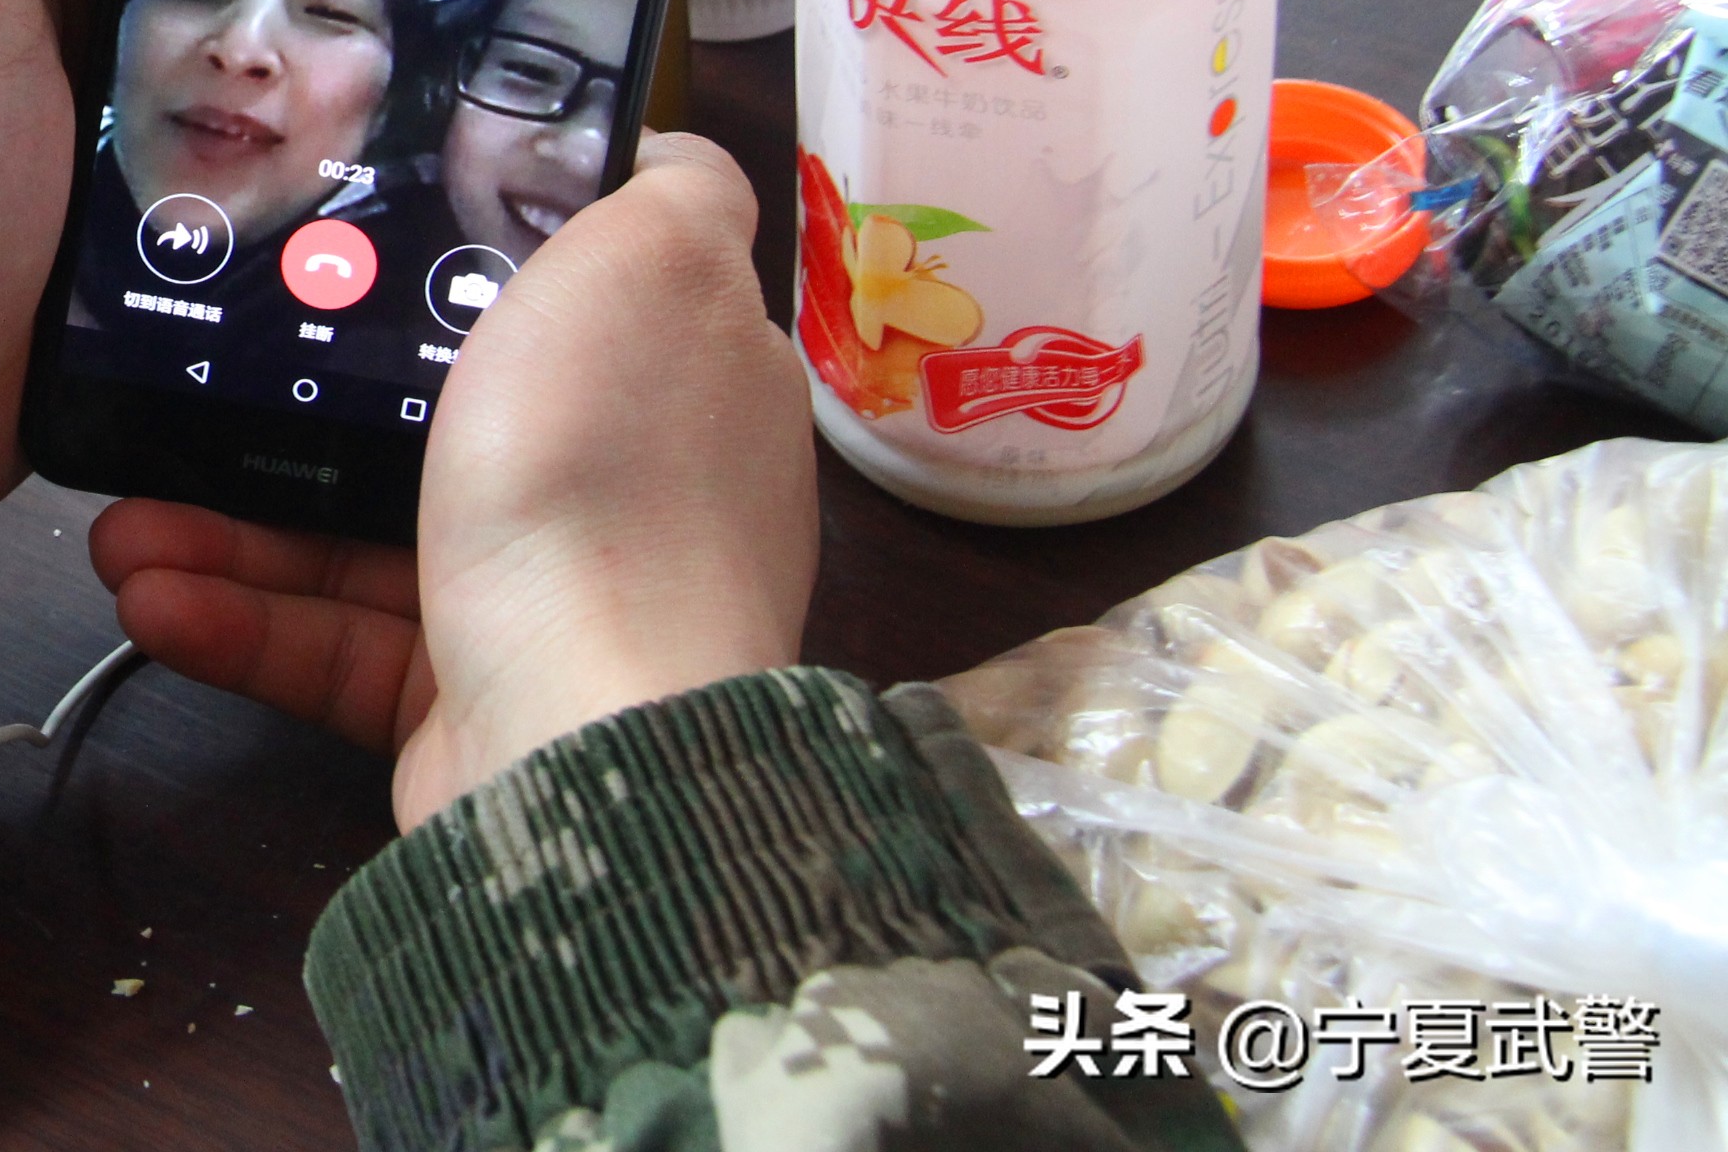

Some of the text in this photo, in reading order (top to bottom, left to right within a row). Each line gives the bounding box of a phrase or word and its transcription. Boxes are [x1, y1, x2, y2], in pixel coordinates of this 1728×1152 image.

[318, 158, 376, 185] 00:23
[123, 289, 223, 325] 切到语音通话
[298, 321, 334, 344] 挂断
[417, 343, 460, 365] 转换
[242, 452, 339, 485] HUAWEI
